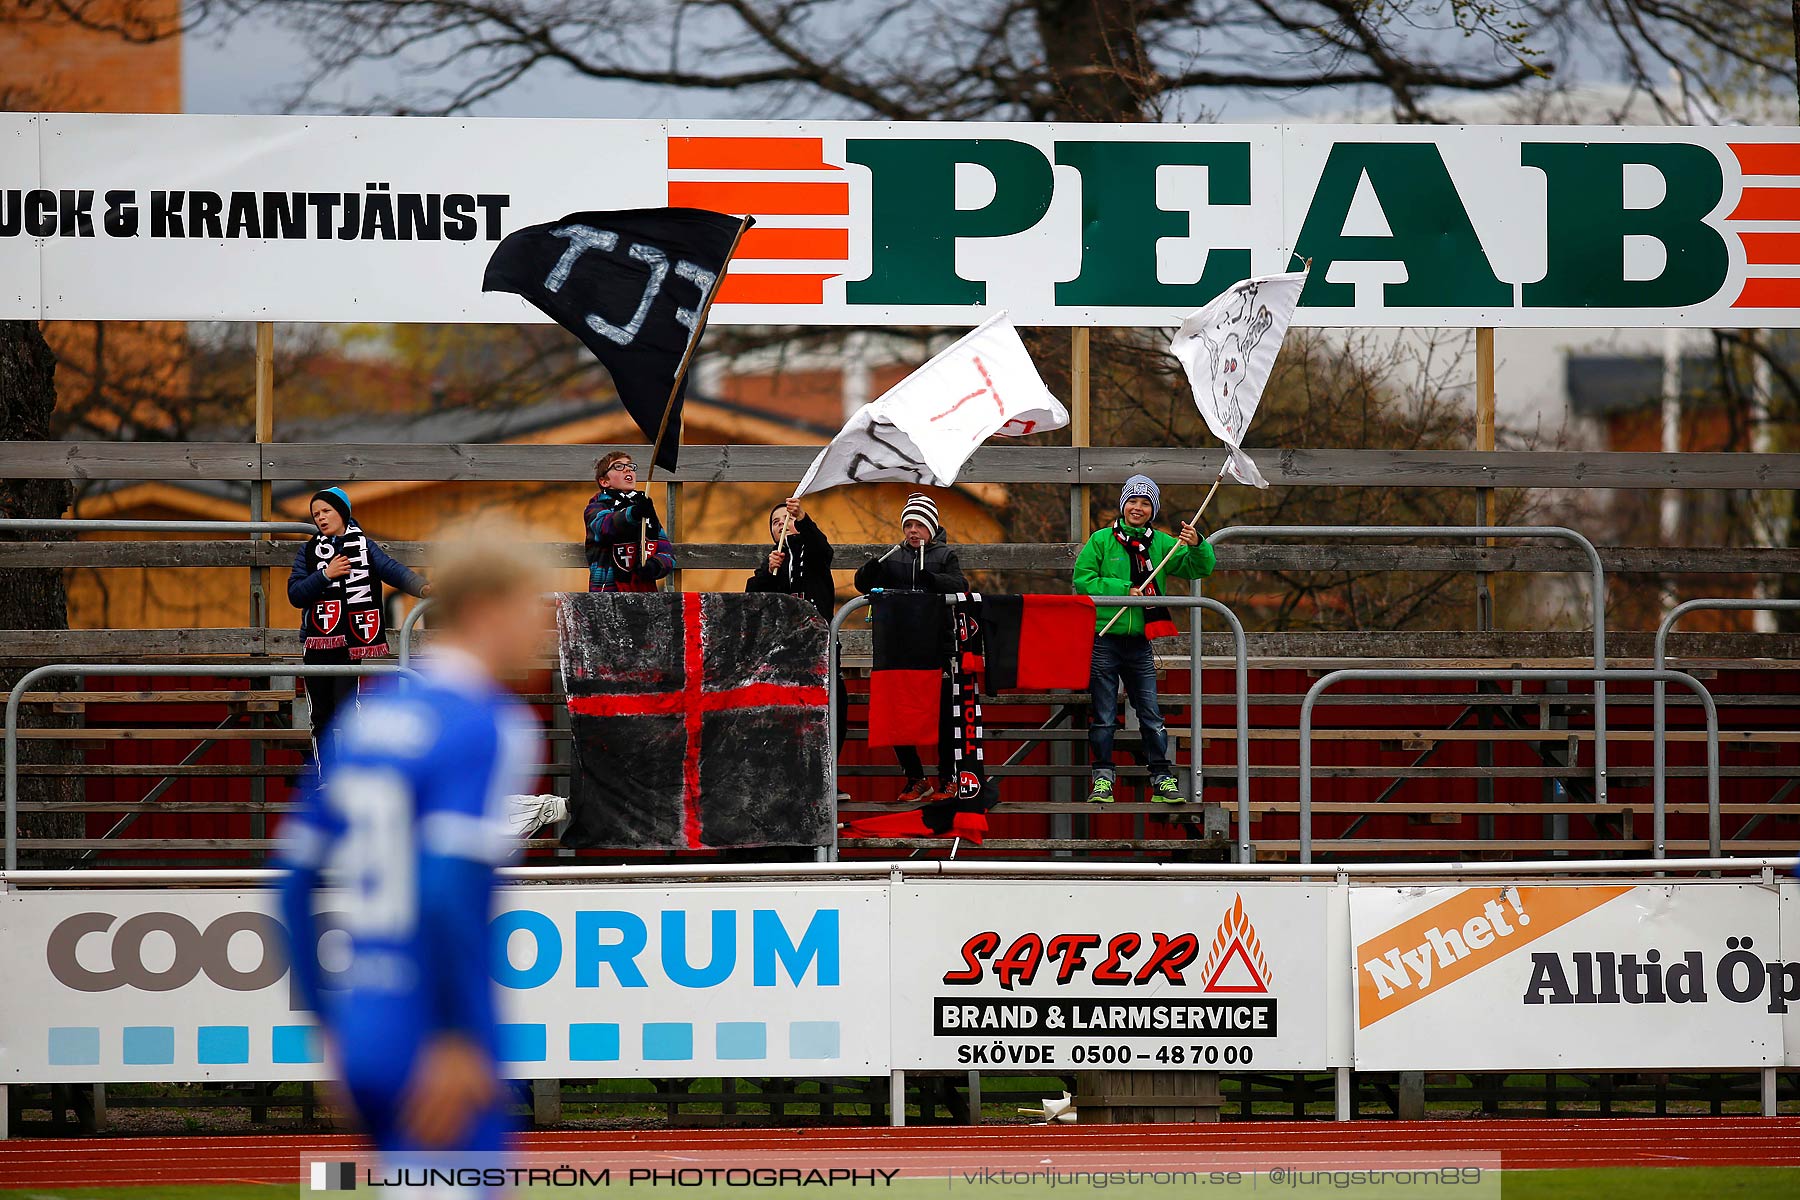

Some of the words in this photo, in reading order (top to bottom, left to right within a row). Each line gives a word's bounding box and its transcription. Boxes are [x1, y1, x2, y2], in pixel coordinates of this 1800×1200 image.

[104, 190, 140, 238] &
[151, 183, 510, 240] KRANTJÄNST
[846, 139, 1729, 308] PEAB
[490, 909, 840, 989] ORUM
[943, 932, 1199, 991] SAFER
[1363, 886, 1530, 1000] Nyhet!
[1524, 949, 1707, 1004] Alltid
[942, 1005, 1038, 1030] BRAND
[1046, 1005, 1065, 1030] &
[1073, 1005, 1268, 1030] LARMSERVICE
[957, 1041, 1055, 1065] SKÖVDE
